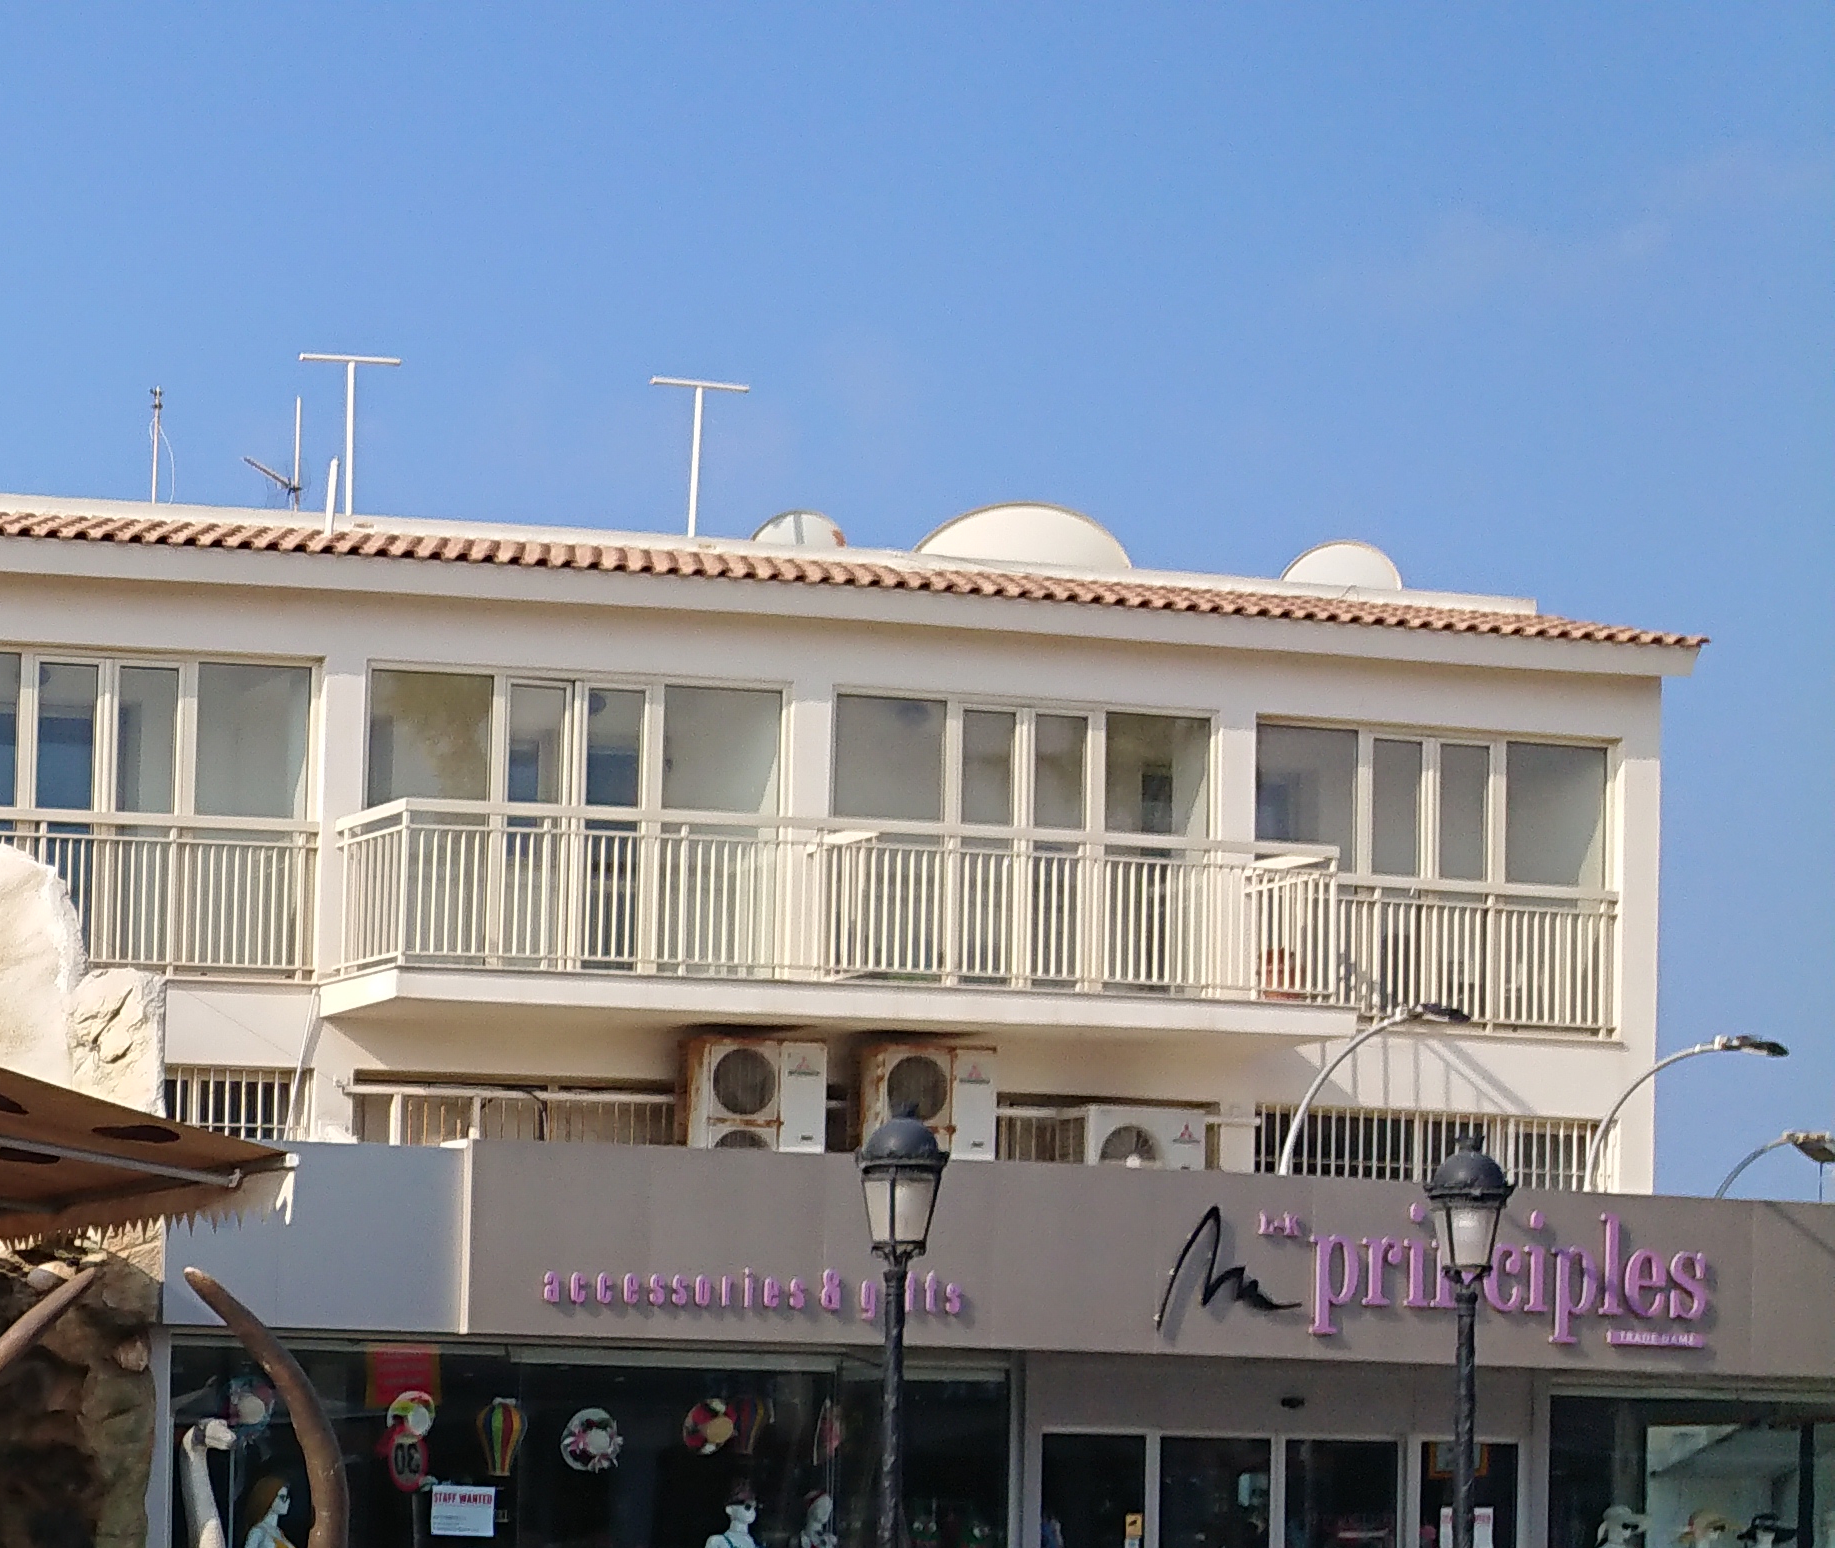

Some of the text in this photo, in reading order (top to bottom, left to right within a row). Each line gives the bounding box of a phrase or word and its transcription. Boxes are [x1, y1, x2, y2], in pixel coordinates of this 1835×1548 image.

[543, 1266, 962, 1321] accessories & gfts
[433, 1492, 493, 1506] STAFF WANTED
